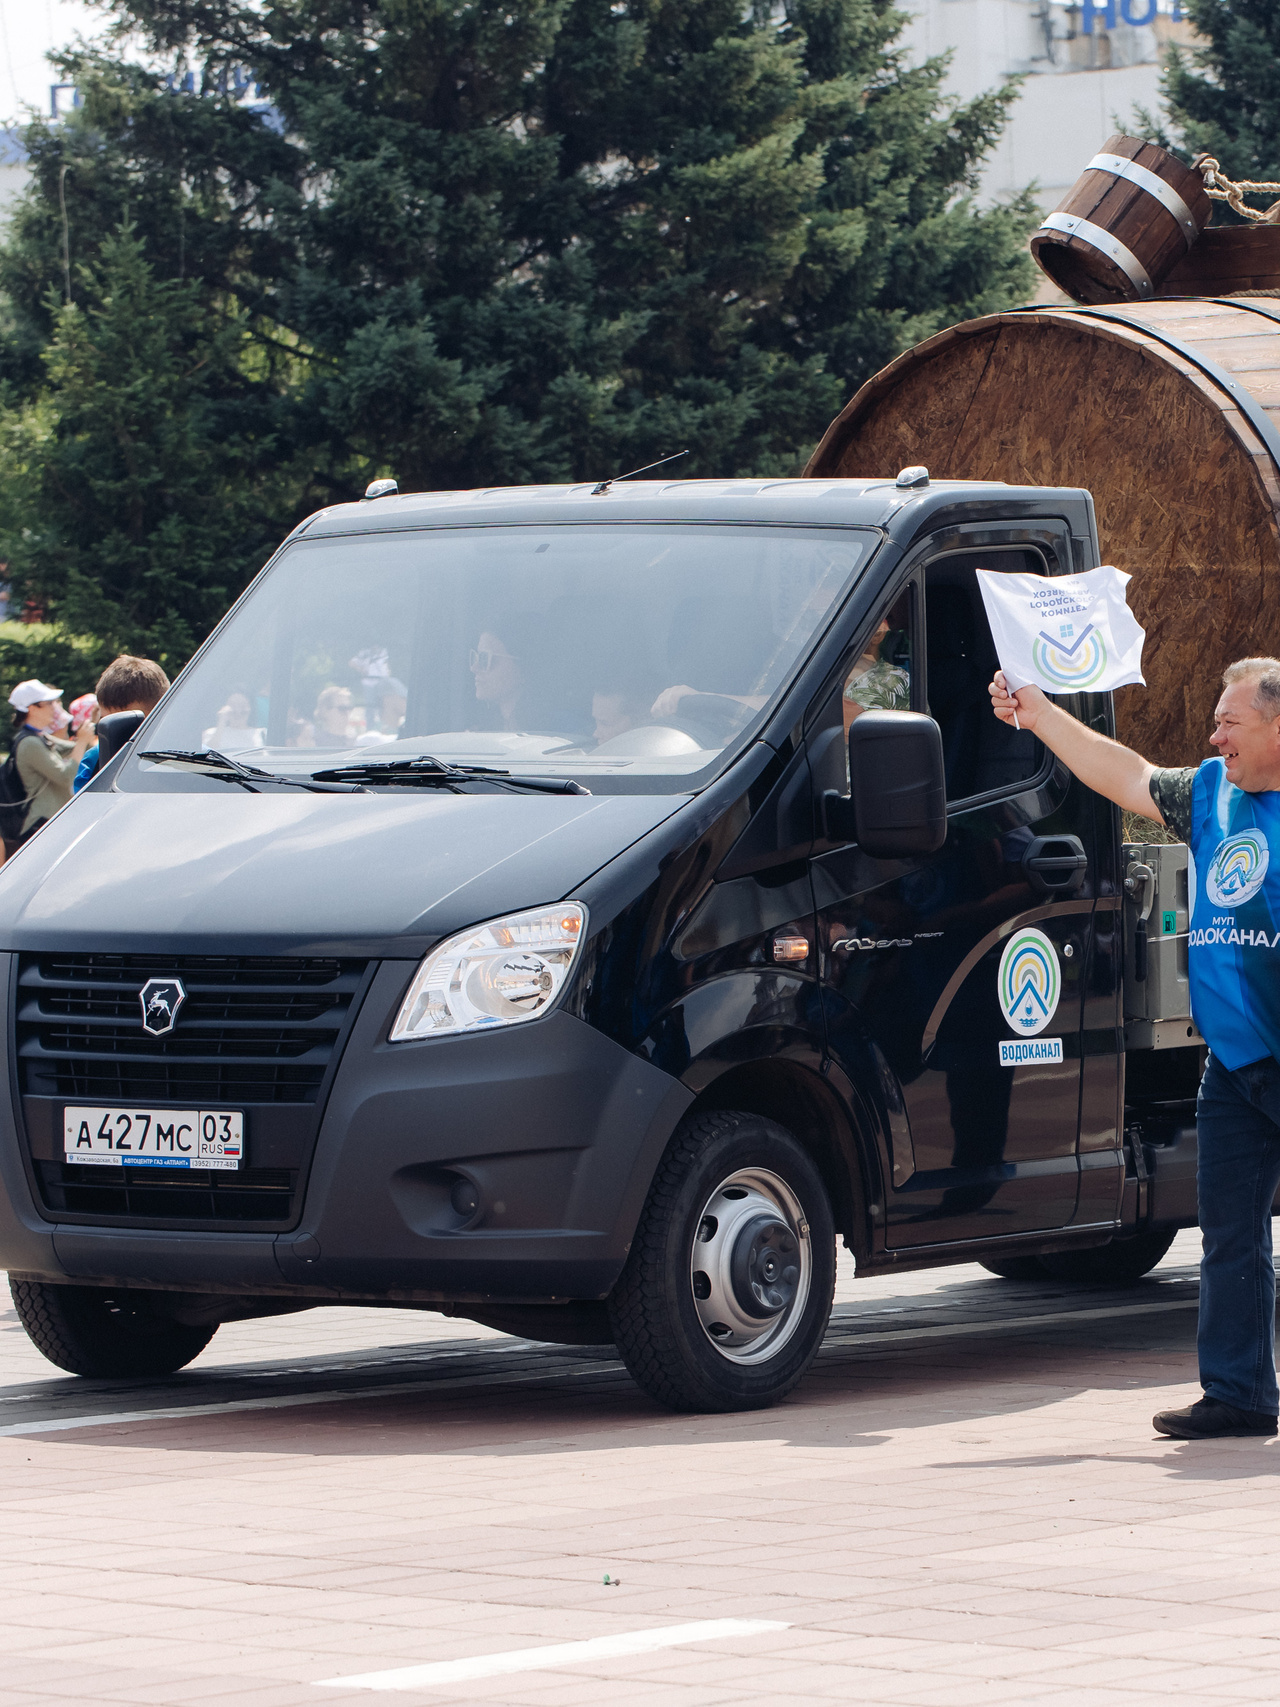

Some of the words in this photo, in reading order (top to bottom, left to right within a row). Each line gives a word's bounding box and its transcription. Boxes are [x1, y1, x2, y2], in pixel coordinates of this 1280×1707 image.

[1212, 916, 1235, 926] МУП
[1001, 1042, 1061, 1062] ВОДОКАНАЛ
[202, 1114, 232, 1143] 03
[201, 1143, 223, 1154] RUS
